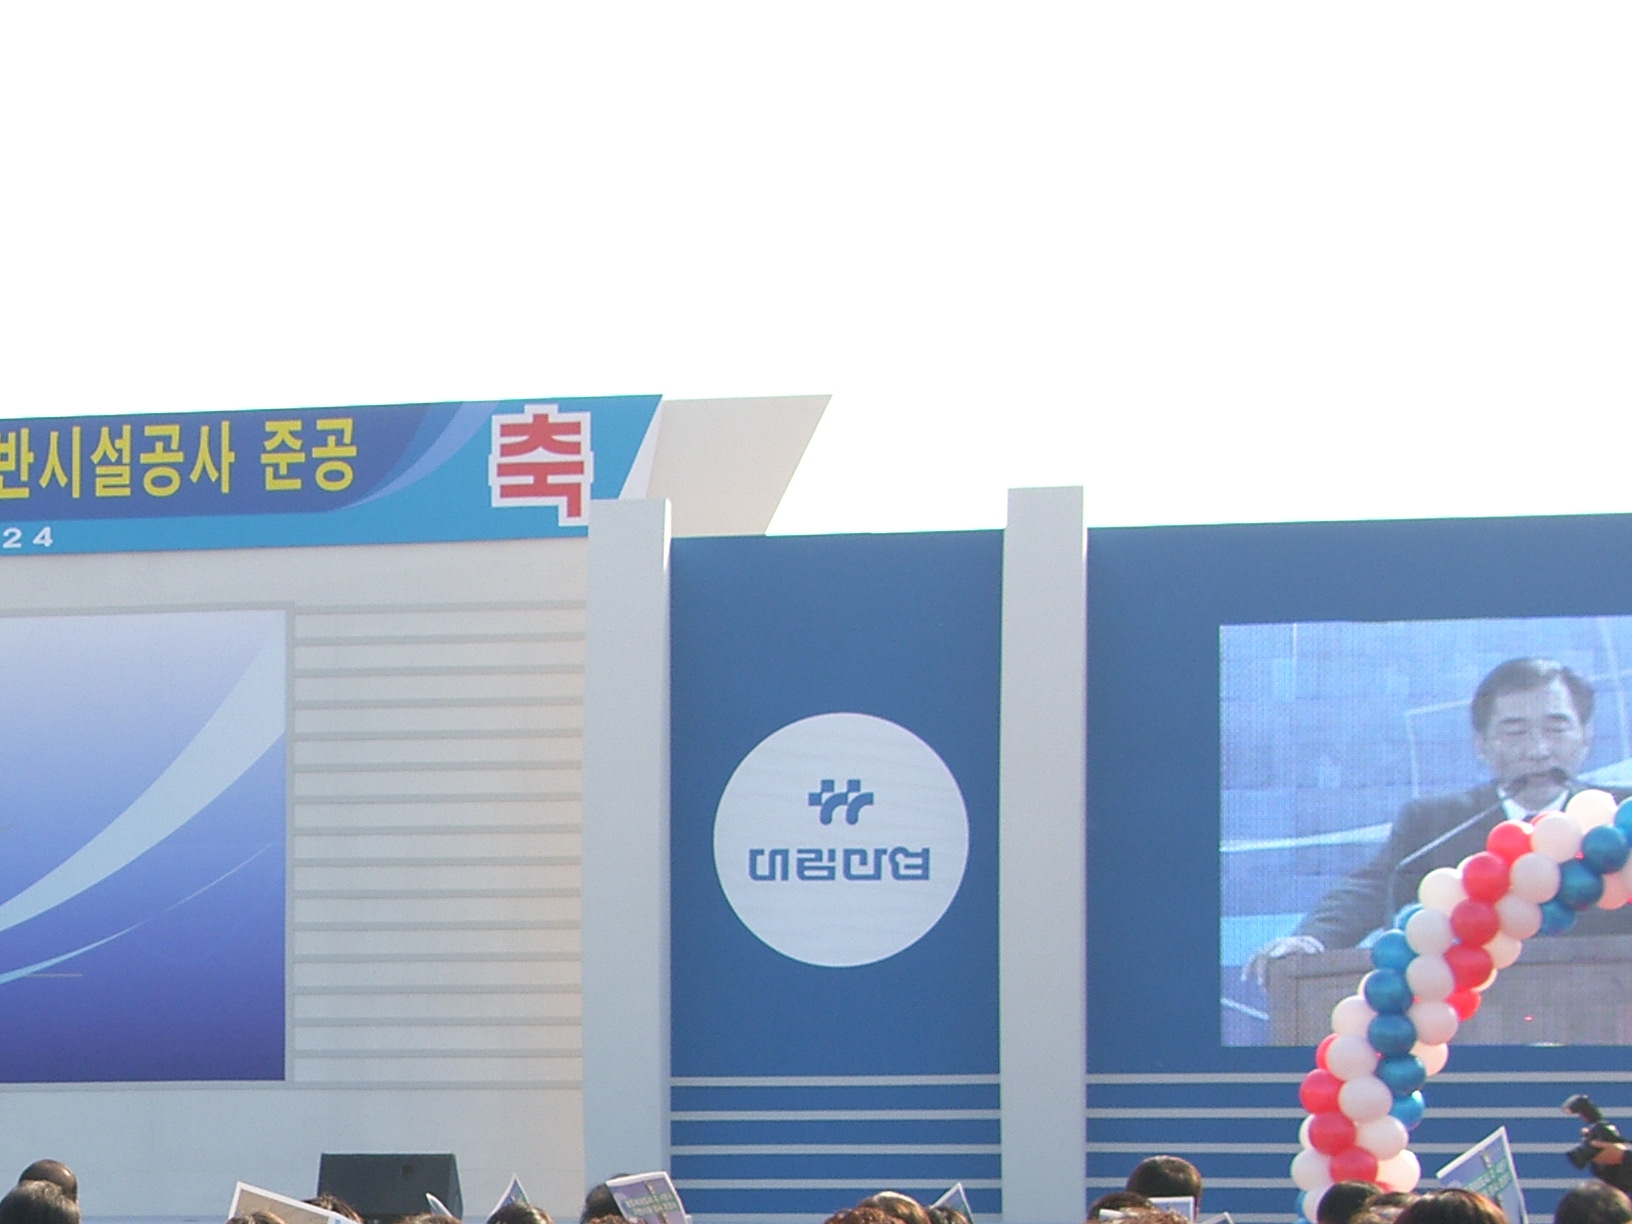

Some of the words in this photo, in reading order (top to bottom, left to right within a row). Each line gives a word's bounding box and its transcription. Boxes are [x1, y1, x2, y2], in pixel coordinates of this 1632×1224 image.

[260, 417, 357, 492] 준공
[494, 406, 590, 524] 축
[3, 526, 54, 549] 24
